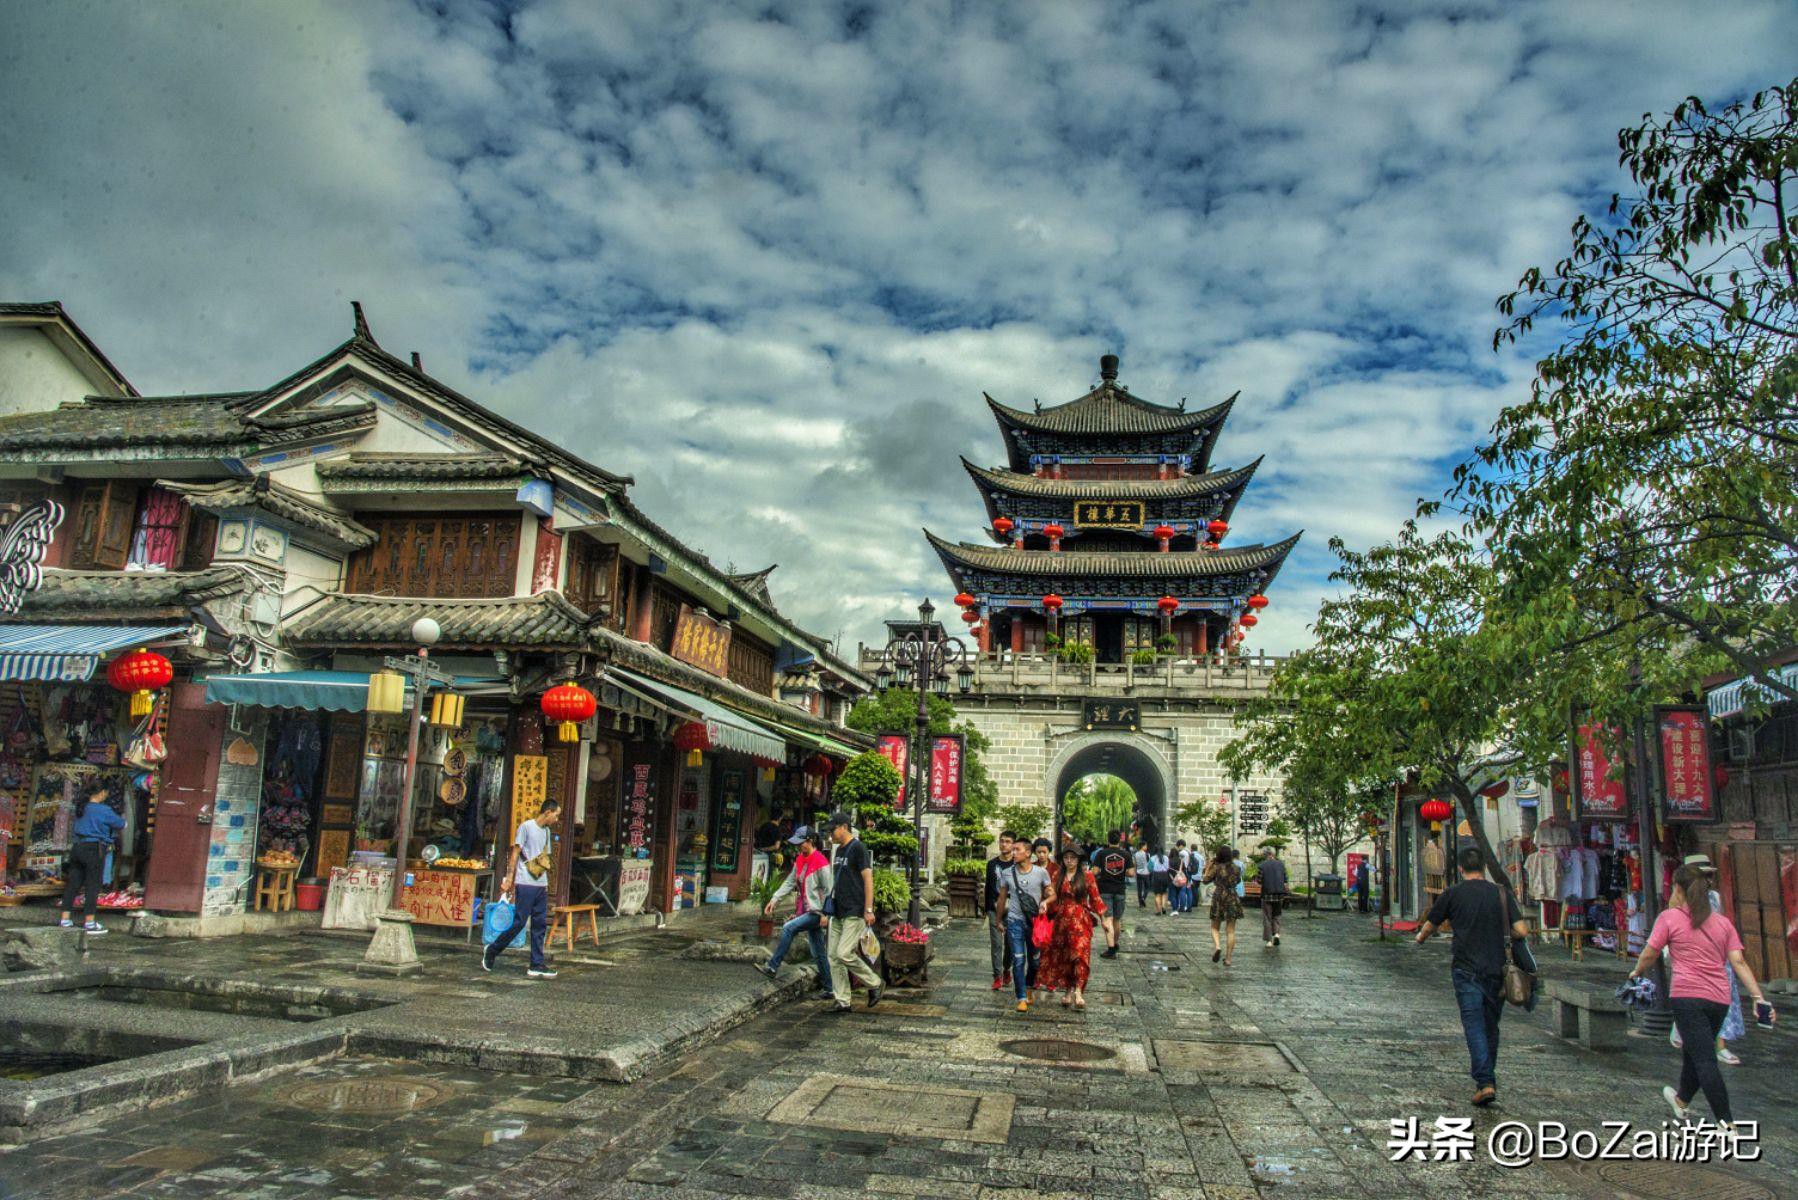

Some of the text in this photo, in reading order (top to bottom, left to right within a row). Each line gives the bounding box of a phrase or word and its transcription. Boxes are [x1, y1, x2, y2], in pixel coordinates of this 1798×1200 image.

[1582, 750, 1596, 790] 合理用水
[1689, 729, 1705, 795] 喜迎十九大
